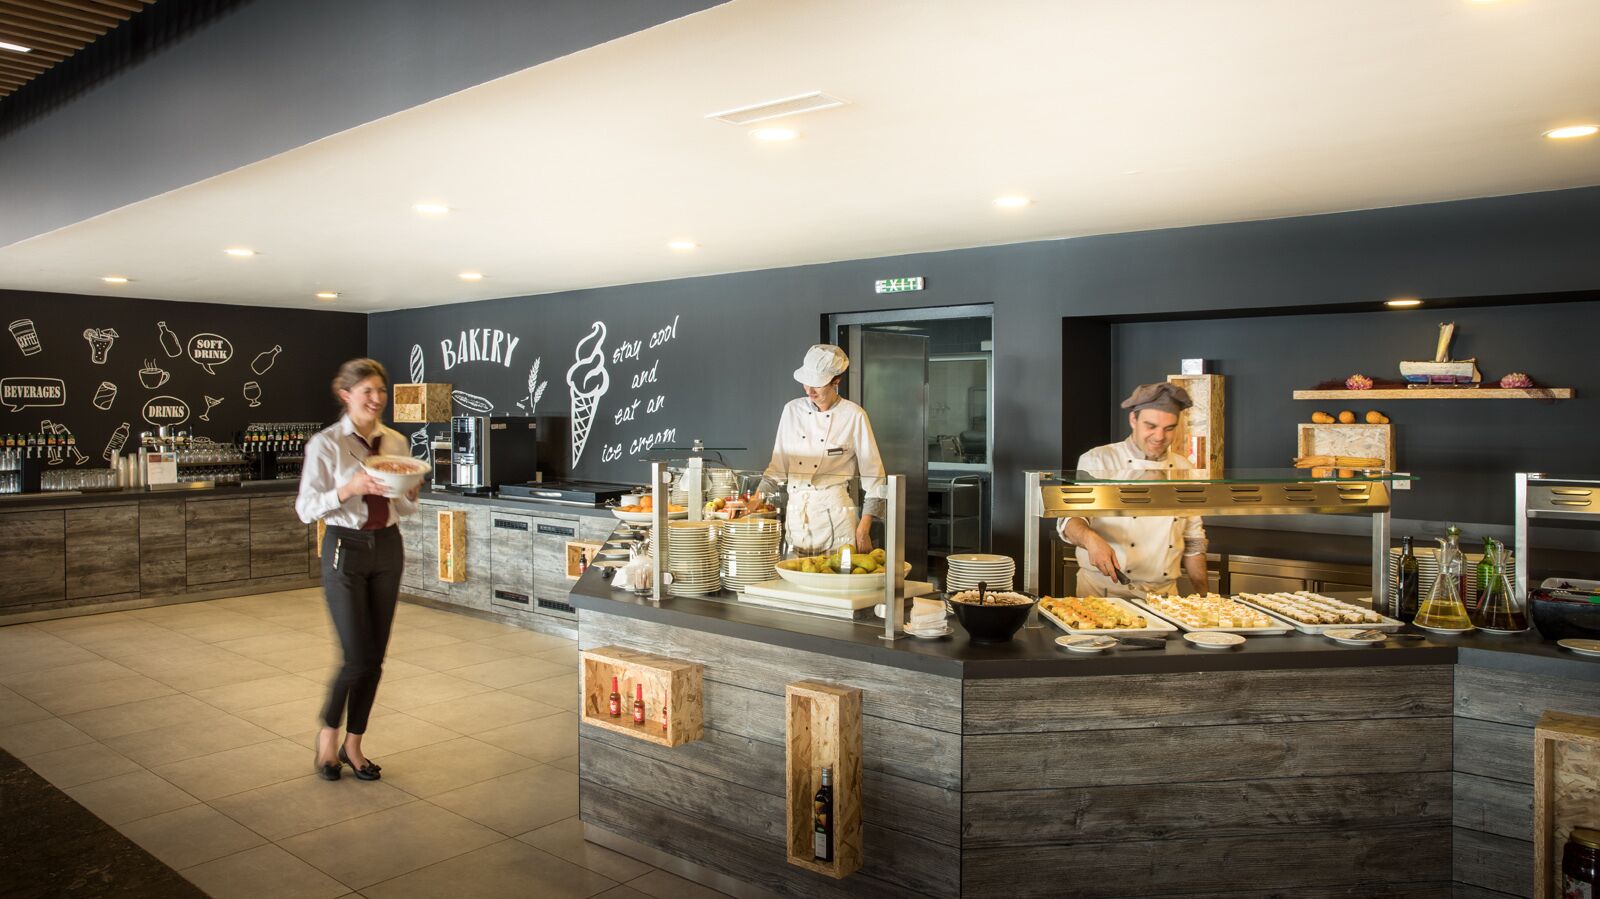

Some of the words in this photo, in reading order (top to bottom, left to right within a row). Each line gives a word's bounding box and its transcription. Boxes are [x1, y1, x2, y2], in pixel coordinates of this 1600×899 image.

[880, 277, 916, 292] EXIT
[196, 339, 224, 350] SOFT
[440, 328, 520, 371] BAKERY
[612, 340, 641, 364] stay
[649, 315, 680, 349] cool
[194, 349, 228, 359] DRINK
[631, 359, 660, 390] and
[3, 385, 62, 399] BEVERAGES
[148, 404, 185, 418] DRINKS
[614, 400, 641, 426] eat
[646, 393, 665, 414] an
[601, 441, 623, 463] ice
[629, 426, 677, 456] cream
